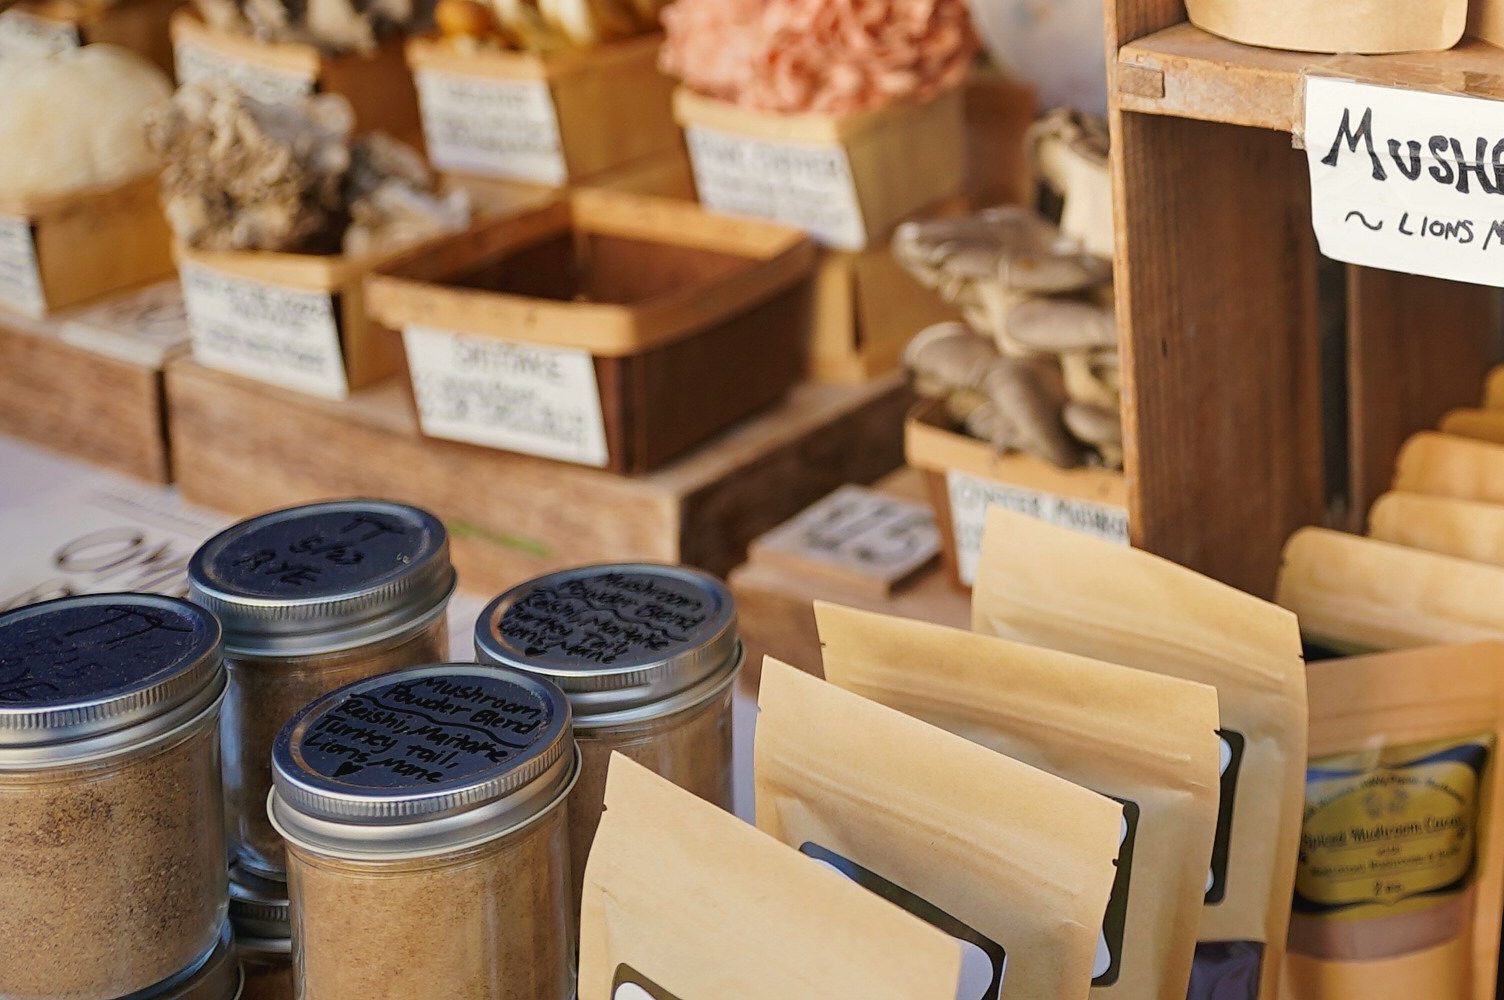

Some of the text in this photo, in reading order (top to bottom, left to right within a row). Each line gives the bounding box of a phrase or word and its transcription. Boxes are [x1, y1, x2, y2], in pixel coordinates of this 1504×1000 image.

[1398, 212, 1474, 244] LIONS
[382, 682, 541, 735] Powder Blend
[411, 677, 543, 719] Mushroom
[303, 732, 371, 764] Lions
[315, 714, 398, 754] Turkey
